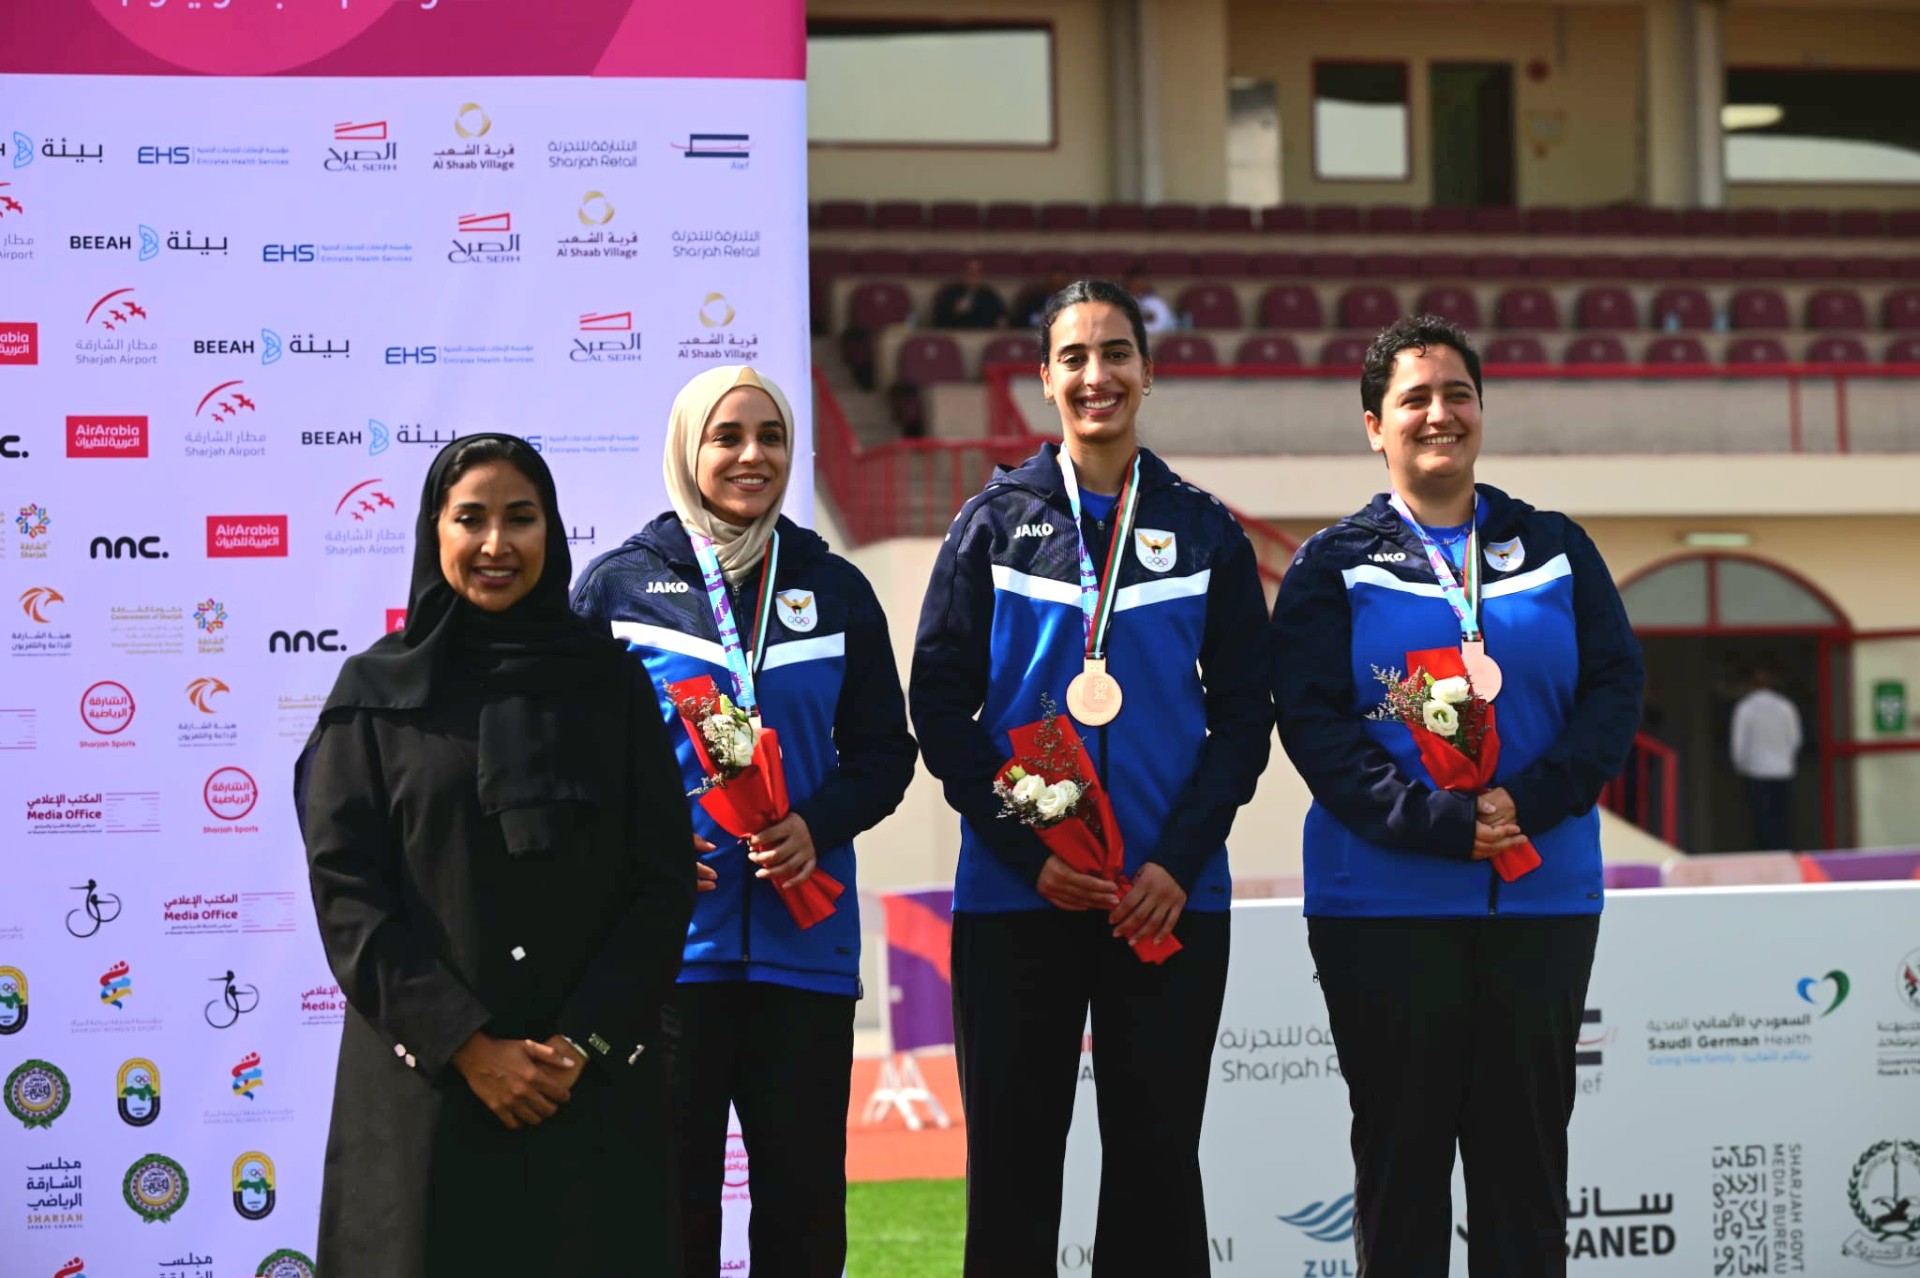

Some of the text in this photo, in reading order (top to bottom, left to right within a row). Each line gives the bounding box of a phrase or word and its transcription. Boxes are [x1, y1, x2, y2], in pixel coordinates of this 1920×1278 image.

[42, 138, 103, 163] بيئة
[138, 146, 190, 164] EHS
[484, 144, 514, 158] قرية
[433, 158, 514, 171] Al Shaab Village
[549, 155, 638, 170] Sharjah Retail
[70, 235, 131, 250] BEEAH
[167, 231, 228, 255] بيئة
[607, 232, 638, 246] قرية
[263, 244, 315, 262] EHS
[557, 247, 638, 259] Al Shaab Village
[672, 245, 760, 260] Sharjah Retail
[128, 338, 158, 352] مطار
[193, 340, 254, 354] BEEAH
[289, 333, 349, 359] بيئة
[728, 333, 758, 348] قرية
[75, 354, 158, 366] Sharjah Airport
[385, 346, 437, 364] EHS
[678, 349, 758, 361] Al Shaab Village
[75, 424, 140, 436] AirArabia
[237, 431, 267, 445] مطار
[302, 431, 362, 445] BEEAH
[185, 446, 266, 459] Sharjah Airport
[215, 524, 280, 536] AirArabia
[1014, 523, 1055, 538] JAKO
[324, 544, 405, 557] Sharjah Airport
[645, 582, 689, 594] JAKO
[111, 740, 136, 749] Sports
[27, 809, 102, 820] Media Office
[235, 825, 259, 834] Sports
[164, 910, 238, 921] Media Office
[302, 1001, 336, 1011] Media
[1647, 1033, 1812, 1051] Saudi German Health
[1222, 1057, 1320, 1085] Sharjah
[1577, 1073, 1603, 1094] lef
[26, 1156, 82, 1172] مجلس
[26, 1175, 82, 1192] الشارقة
[1789, 1143, 1803, 1223] SHARJAH
[27, 1193, 82, 1211] الرياضي
[1772, 1143, 1788, 1275] MEDIA BUREAU
[27, 1214, 83, 1224] SHARJAH
[158, 1252, 213, 1267] مجلس
[1304, 1259, 1354, 1278] ZUL
